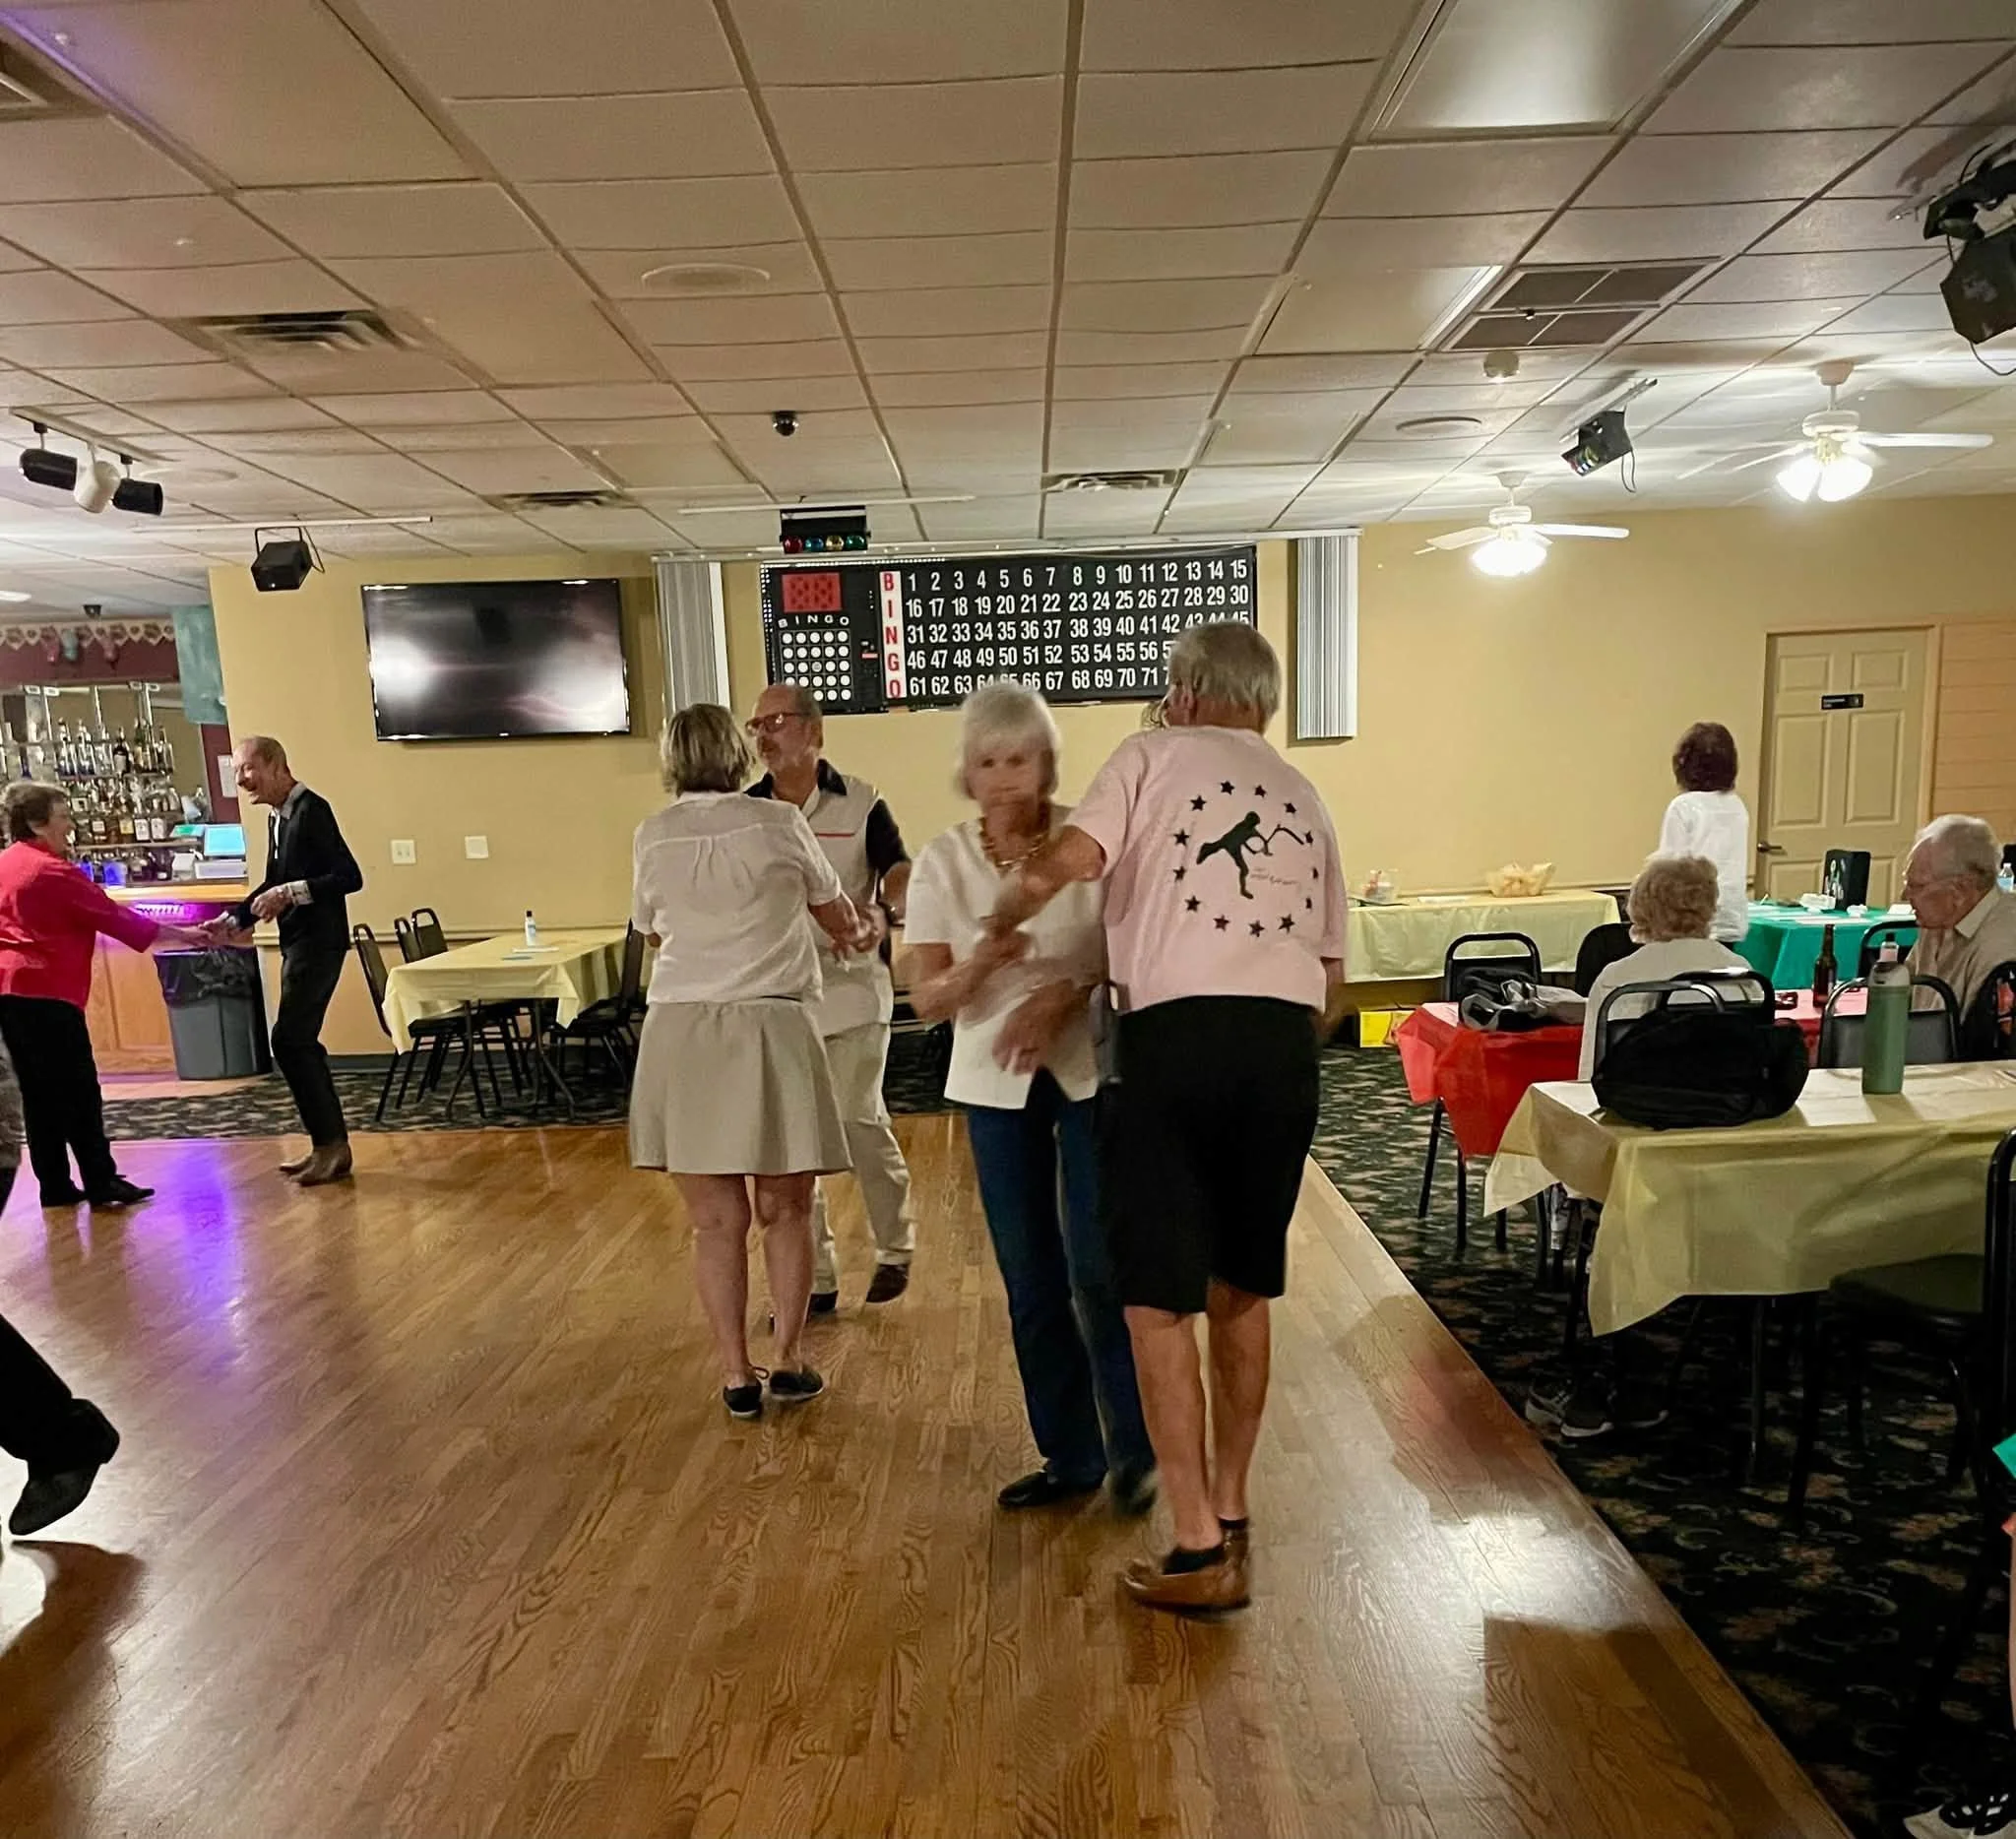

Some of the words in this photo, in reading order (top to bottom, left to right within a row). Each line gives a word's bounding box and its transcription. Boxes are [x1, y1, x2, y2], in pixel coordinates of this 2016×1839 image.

[909, 572, 917, 592] 1
[930, 571, 941, 592] 2
[953, 570, 964, 591] 3
[976, 569, 986, 590] 4
[999, 569, 1010, 589] 5
[1023, 567, 1033, 588] 6
[1044, 566, 1056, 587] 7
[1072, 565, 1083, 587] 8
[1095, 565, 1106, 585] 9
[1114, 563, 1133, 584] 10
[1139, 562, 1156, 583] 11
[1161, 561, 1179, 582] 12
[1184, 560, 1202, 581] 13
[1207, 559, 1225, 580] 14
[1229, 558, 1247, 579] 15
[905, 598, 922, 618] 16
[928, 597, 945, 617] 17
[951, 596, 969, 616] 18
[974, 595, 991, 615] 19
[995, 594, 1016, 615] 20
[1020, 594, 1038, 613] 21
[1041, 593, 1061, 613] 22
[1068, 592, 1089, 612] 23
[1092, 591, 1111, 611] 24
[1114, 590, 1134, 610] 25
[1137, 589, 1158, 609] 26
[1161, 587, 1180, 607] 27
[1183, 586, 1204, 607] 28
[1206, 585, 1226, 606] 29
[1229, 584, 1250, 604] 30
[882, 572, 901, 700] BINGO
[906, 624, 925, 644] 31
[928, 623, 948, 644] 32
[951, 622, 971, 643] 33
[974, 621, 993, 642] 34
[997, 620, 1017, 641] 35
[1020, 619, 1040, 640] 36
[1042, 618, 1062, 640] 37
[1069, 617, 1090, 639] 38
[1093, 616, 1112, 638] 39
[1115, 615, 1135, 636] 40
[1139, 614, 1158, 635] 41
[1161, 613, 1181, 634] 42
[1184, 612, 1204, 630] 43
[907, 650, 926, 670] 46
[929, 649, 948, 669] 47
[952, 648, 973, 668] 48
[976, 647, 995, 667] 49
[998, 646, 1018, 666] 50
[1023, 645, 1040, 666] 51
[1043, 644, 1063, 665] 52
[1070, 644, 1090, 665] 53
[1093, 643, 1112, 664] 54
[1116, 642, 1136, 663] 55
[1139, 640, 1159, 662] 56
[1162, 640, 1179, 660] 5
[909, 676, 927, 696] 61
[930, 675, 950, 696] 62
[953, 674, 974, 695] 63
[976, 673, 995, 690] 64
[1022, 671, 1041, 692] 66
[1044, 670, 1064, 691] 67
[1071, 669, 1091, 690] 68
[1094, 668, 1113, 689] 69
[1116, 667, 1136, 688] 70
[1141, 666, 1159, 687] 71
